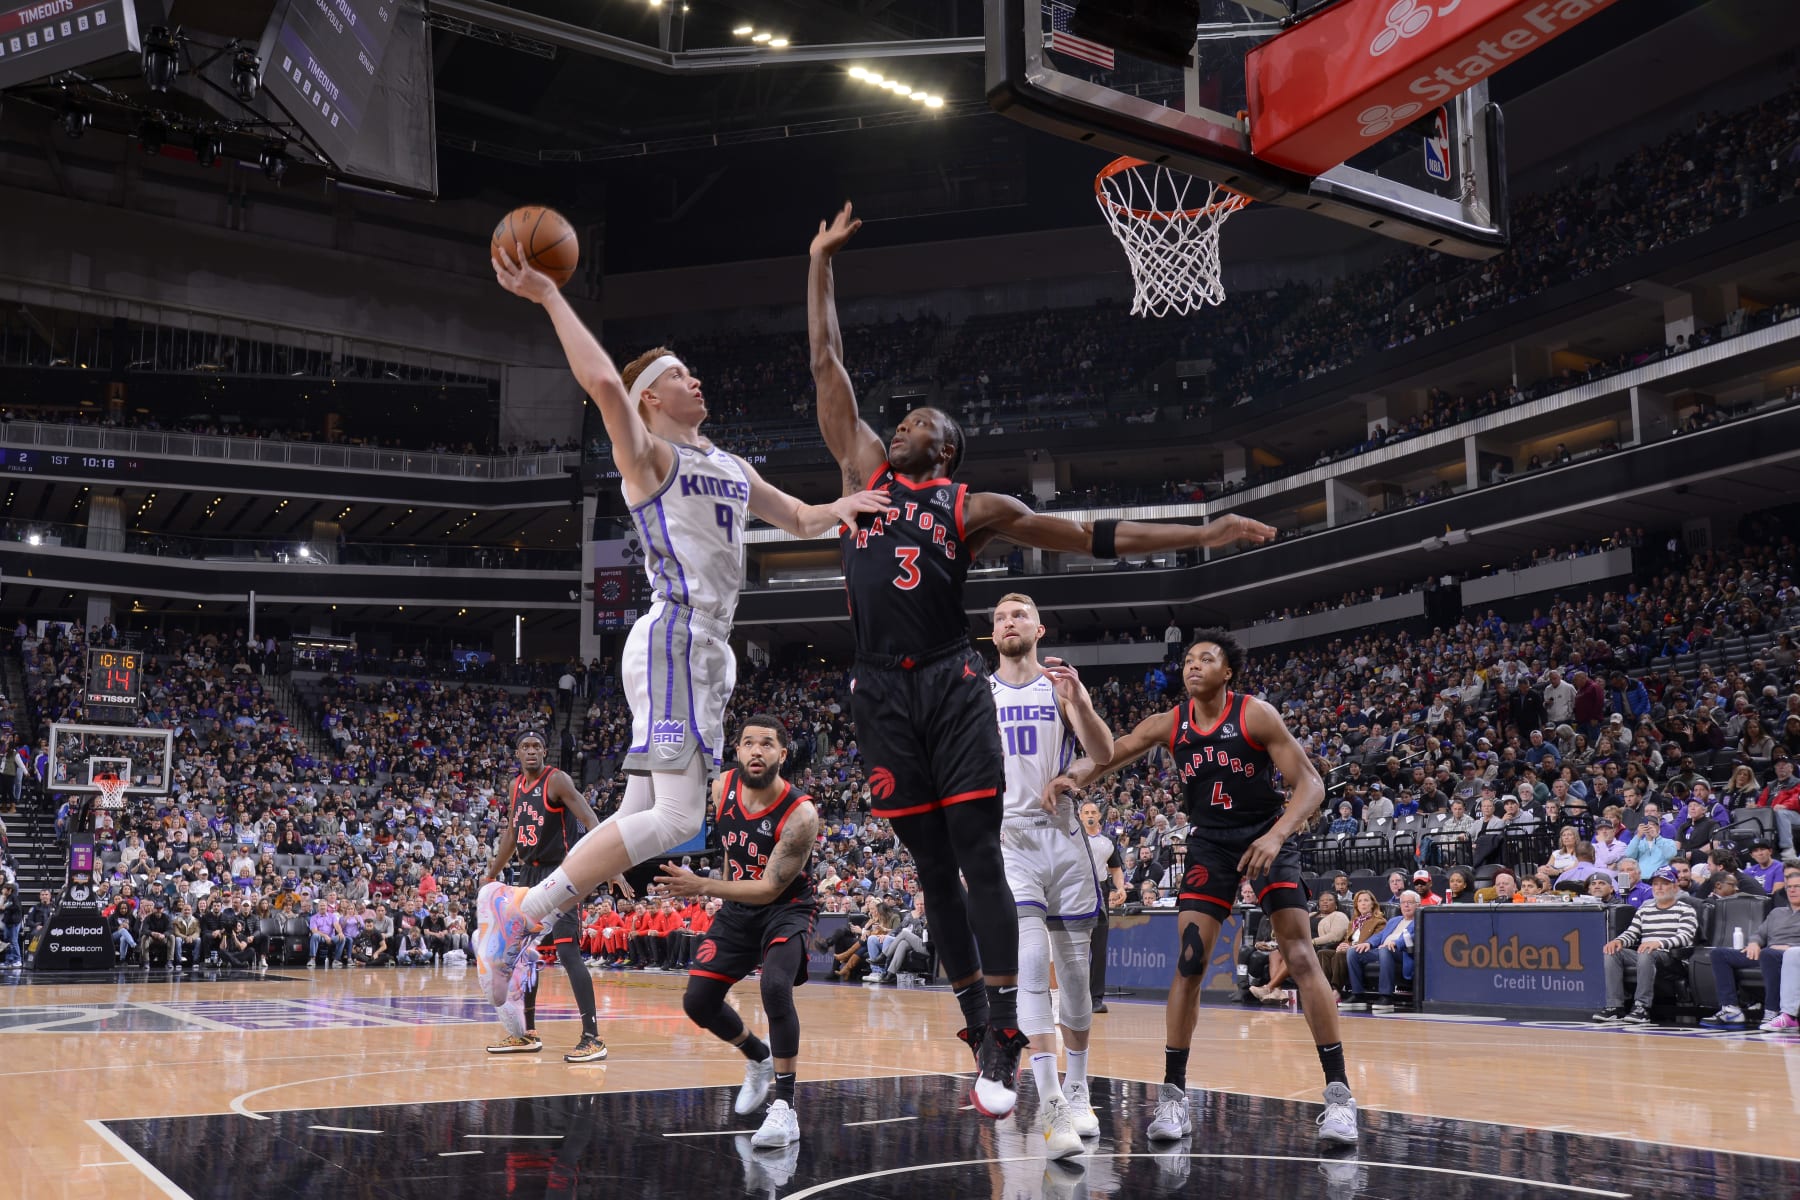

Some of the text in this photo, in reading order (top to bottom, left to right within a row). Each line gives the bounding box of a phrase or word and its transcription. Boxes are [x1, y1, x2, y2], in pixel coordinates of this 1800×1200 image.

[18, 0, 74, 25] TIMEOUTS
[358, 51, 375, 75] BONUS
[1409, 25, 1538, 101] State
[307, 56, 339, 101] TIMEOUTS
[1428, 158, 1441, 175] NBA
[19, 452, 28, 463] 2
[51, 455, 69, 465] 1ST
[82, 457, 115, 469] 10:16
[754, 455, 767, 464] PM
[679, 474, 748, 502] KINGS
[714, 502, 733, 543] 9
[856, 502, 956, 560] RAPTORS
[892, 546, 921, 590] 3
[100, 654, 134, 669] 10:16
[107, 670, 130, 691] 14
[102, 695, 136, 704] TISSOT
[1000, 705, 1055, 722] INGS
[1182, 721, 1189, 730] 6
[653, 733, 684, 744] SAC
[1004, 725, 1037, 756] 10
[1179, 746, 1255, 784] RAPTORS
[728, 790, 736, 800] 6
[1211, 781, 1232, 810] 4
[517, 824, 538, 847] 43
[65, 926, 104, 937] dialpad
[61, 944, 103, 952] socios.com
[1121, 946, 1166, 968] Union
[1493, 974, 1584, 992] Credit Union
